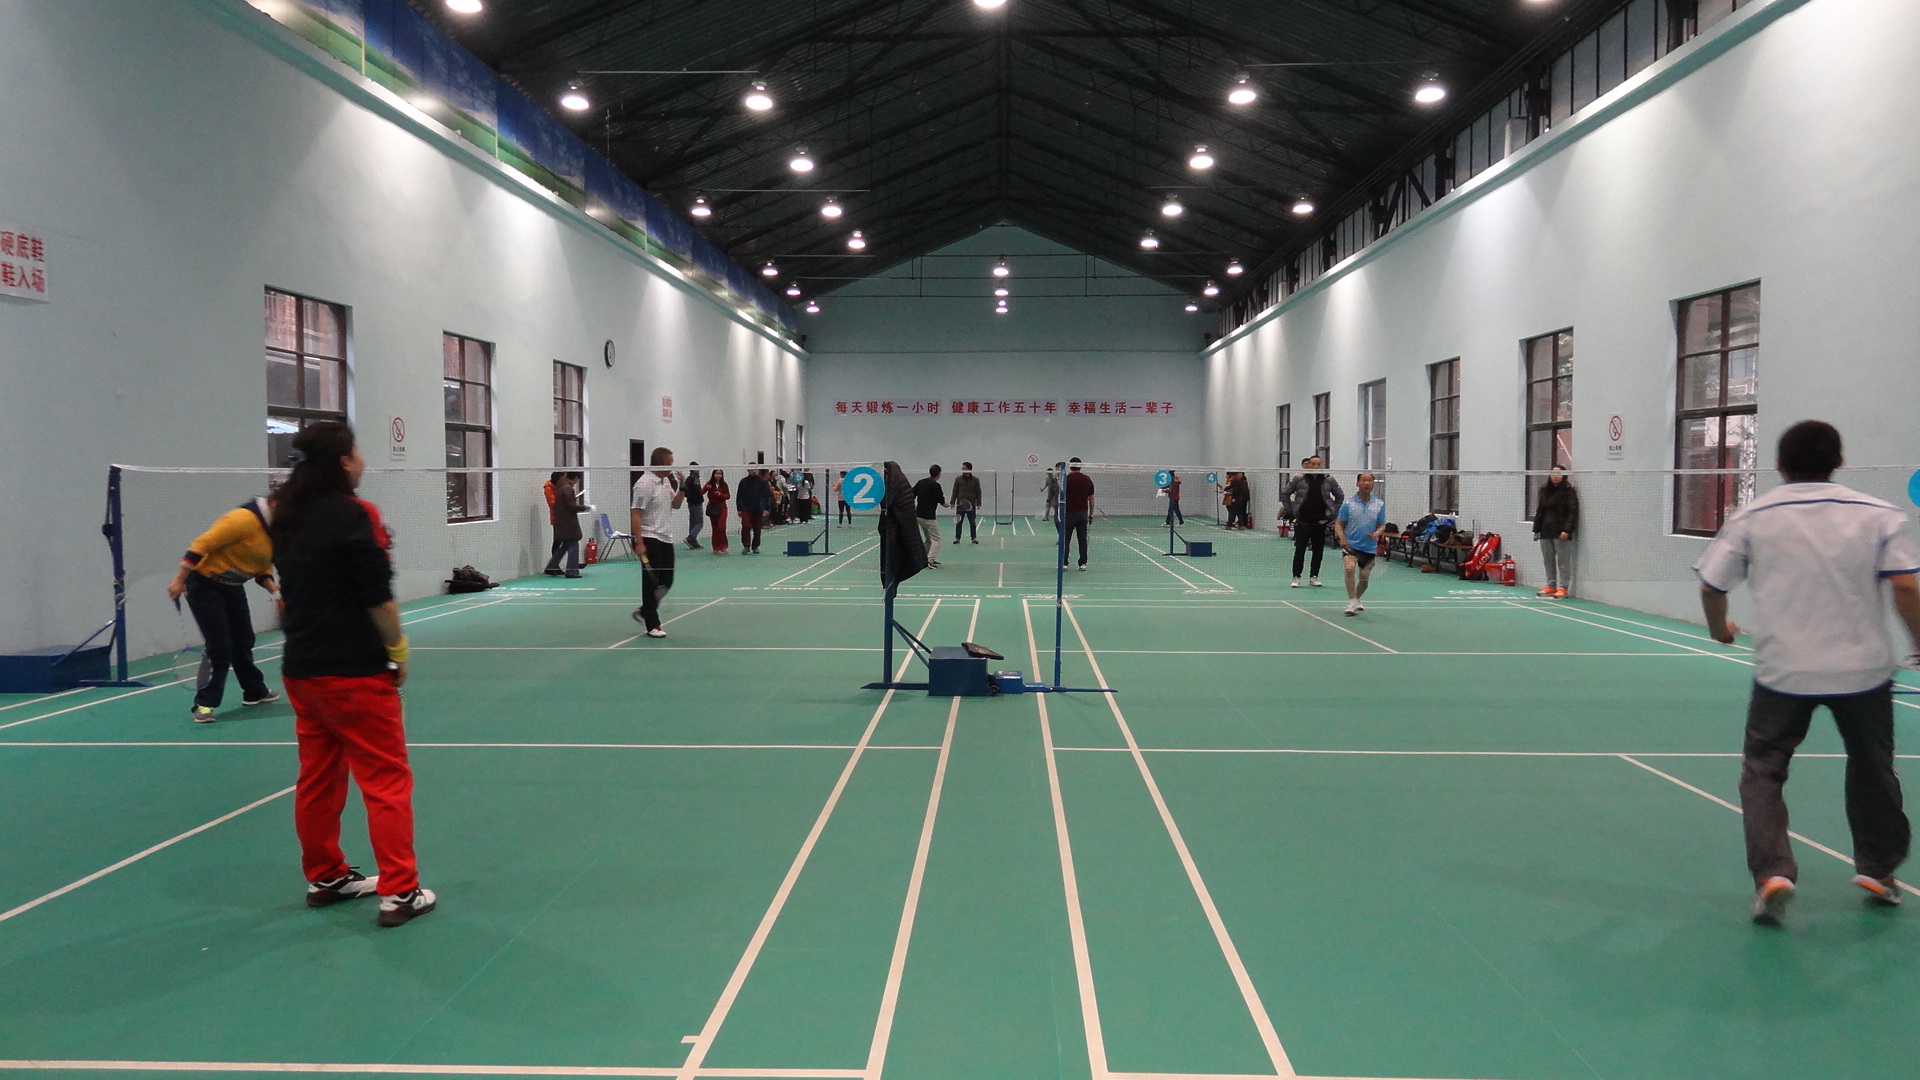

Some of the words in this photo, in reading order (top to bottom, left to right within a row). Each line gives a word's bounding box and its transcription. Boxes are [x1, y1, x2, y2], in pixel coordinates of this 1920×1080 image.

[836, 402, 940, 414] 每天锻炼一小时
[952, 402, 1056, 414] 健康工作五十年
[1068, 402, 1173, 414] 幸福生活一辈子
[1158, 473, 1167, 485] 3
[853, 473, 875, 504] 2
